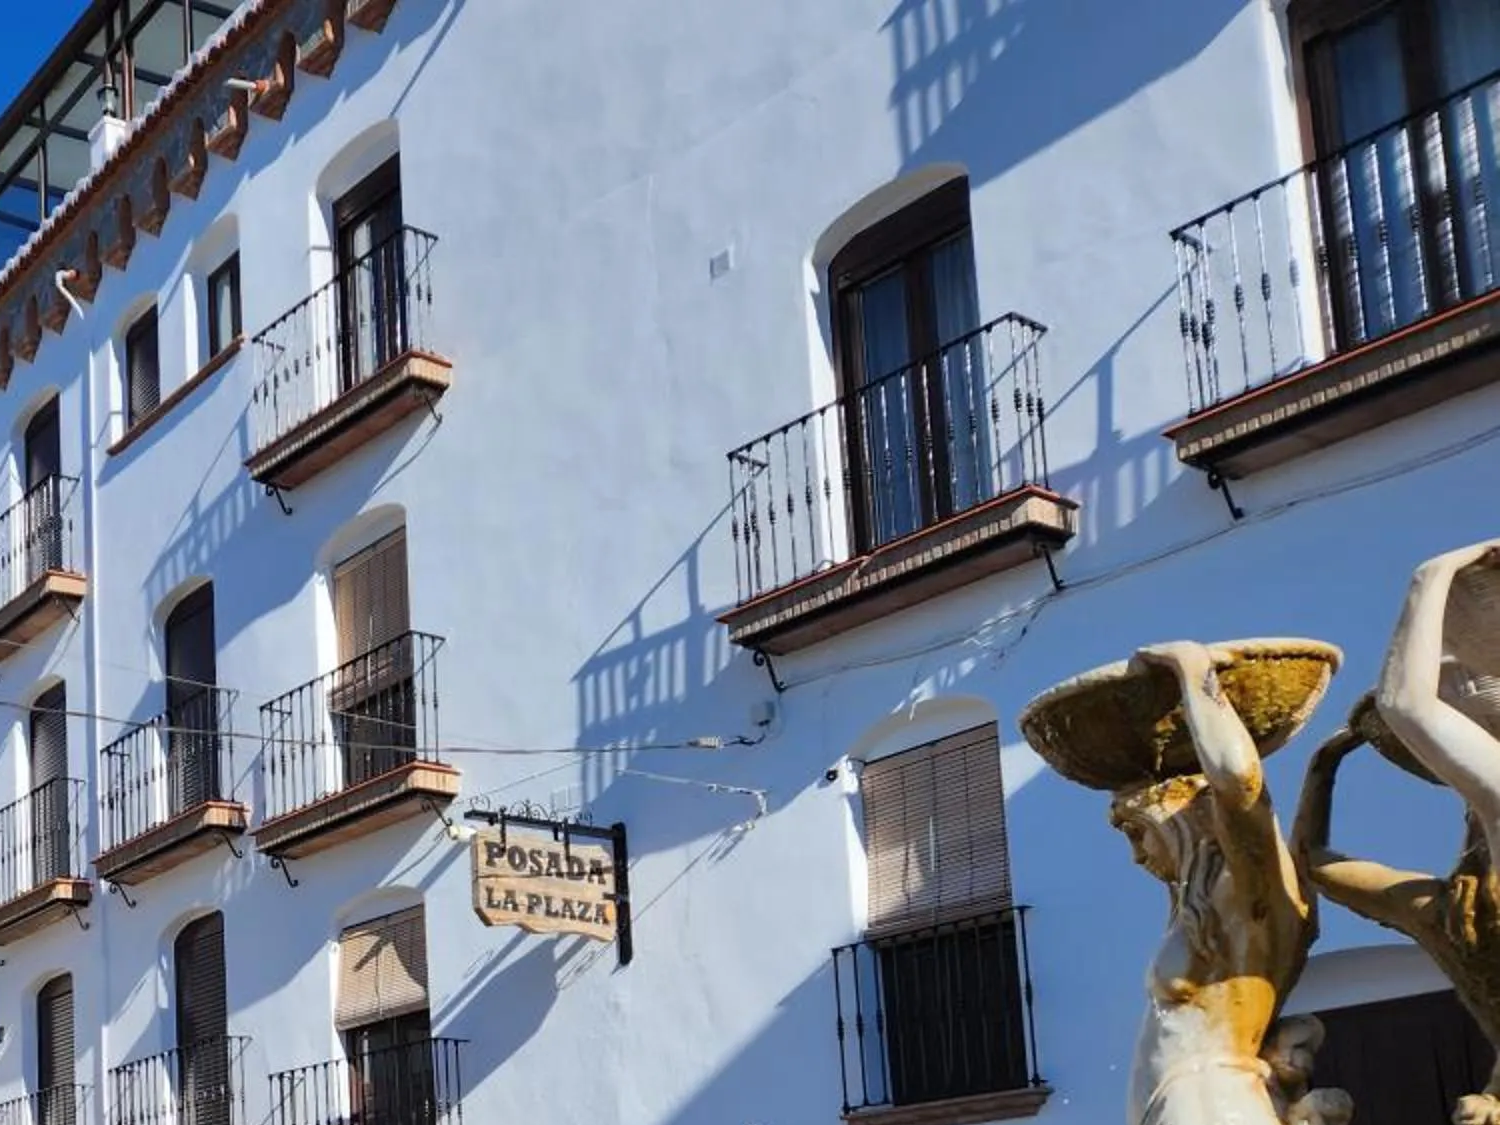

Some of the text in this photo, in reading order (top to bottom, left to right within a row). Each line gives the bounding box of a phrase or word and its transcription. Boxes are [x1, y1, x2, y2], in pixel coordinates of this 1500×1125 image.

[484, 841, 606, 885] POSADA
[485, 886, 611, 925] LA PLAZA
